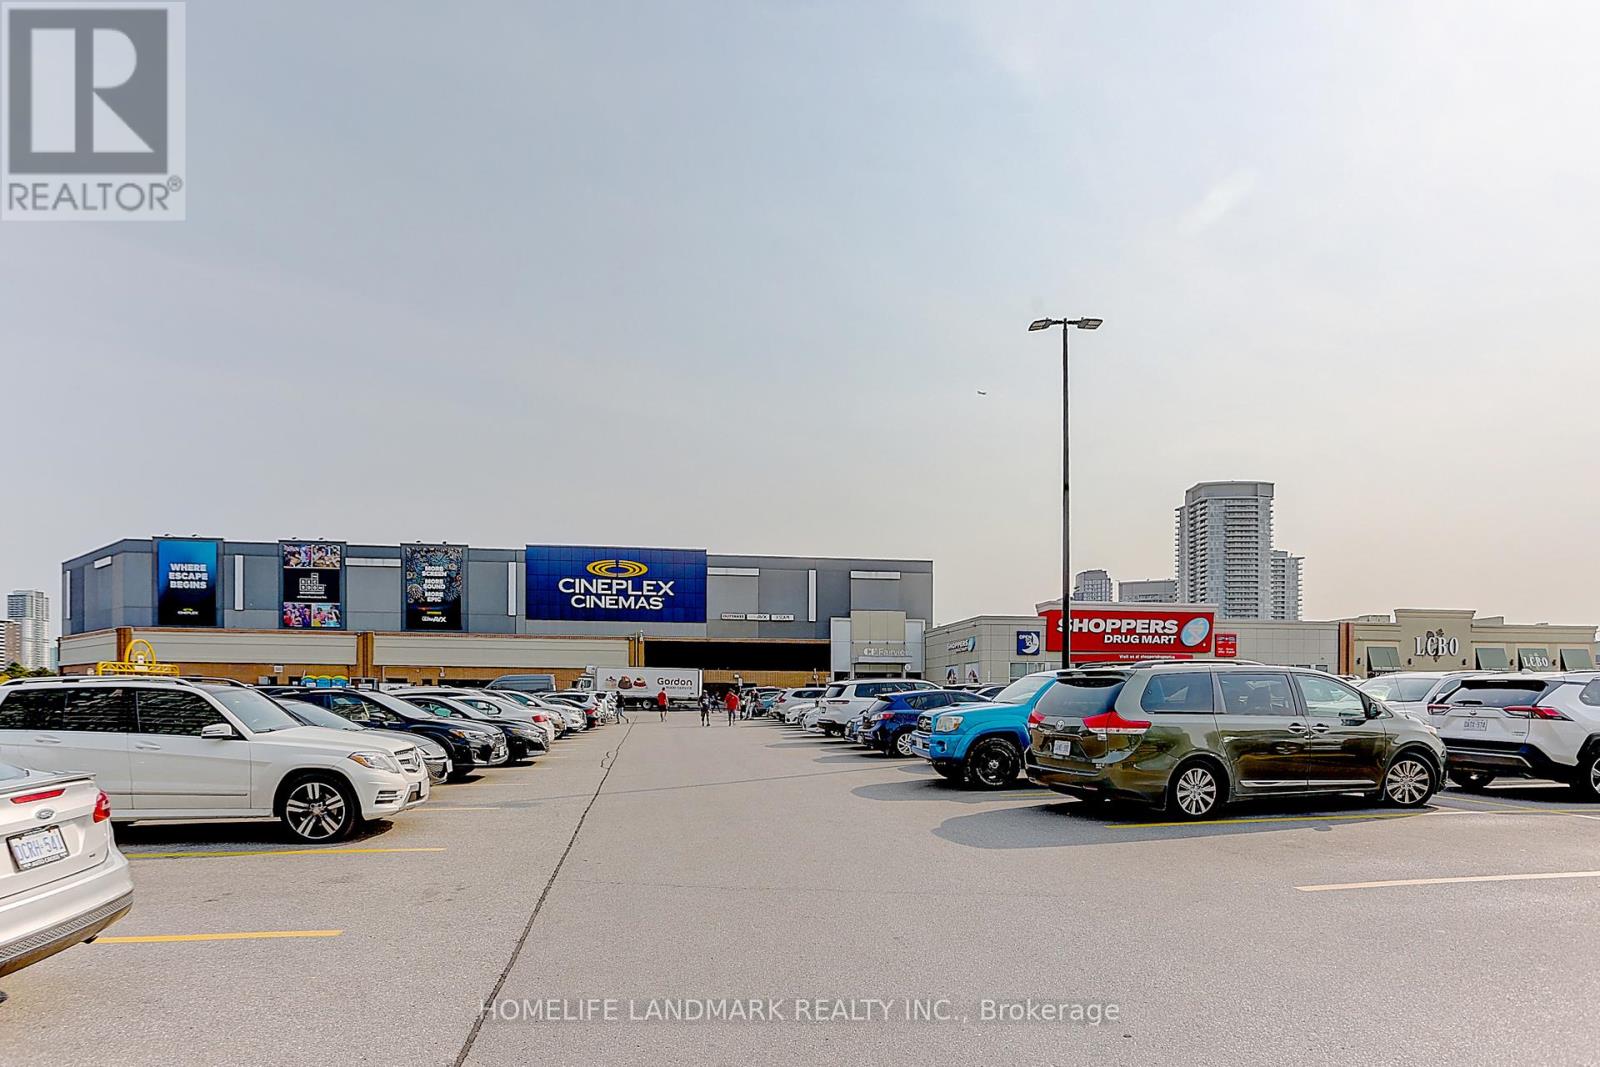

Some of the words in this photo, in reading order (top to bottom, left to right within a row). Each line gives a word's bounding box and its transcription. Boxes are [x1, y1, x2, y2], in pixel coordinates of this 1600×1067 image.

[170, 563, 207, 571] WHERE
[168, 572, 208, 580] ESCAPE
[170, 581, 207, 589] BEGINS
[558, 578, 675, 596] CINEPLEX
[571, 595, 664, 610] CINEMAS
[1057, 618, 1179, 634] SHOPPERS
[1104, 634, 1139, 644] DRUG
[1141, 635, 1177, 644] MART
[1415, 636, 1459, 656] LCBO
[1523, 656, 1549, 667] LCBO
[657, 677, 693, 686] Gordon
